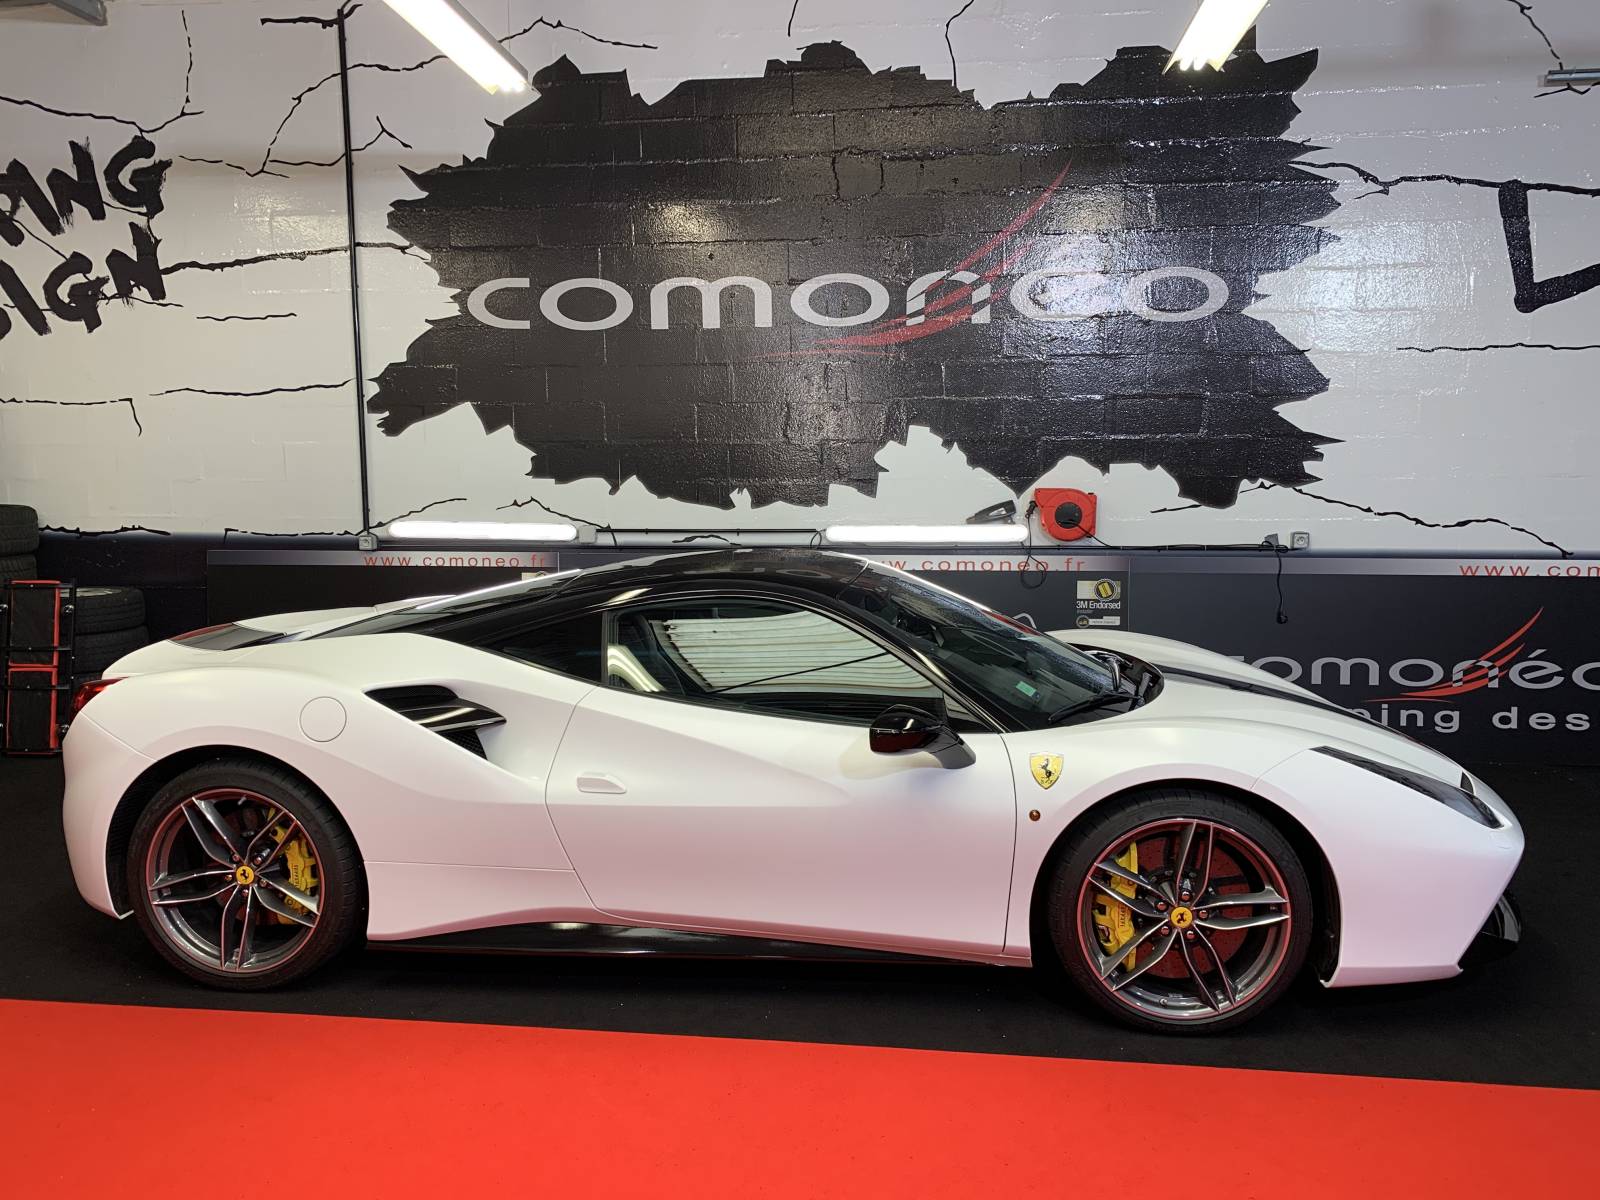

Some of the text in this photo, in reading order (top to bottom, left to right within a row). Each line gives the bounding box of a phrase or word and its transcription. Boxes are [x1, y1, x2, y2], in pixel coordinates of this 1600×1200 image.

[0, 221, 166, 341] IGN
[364, 554, 546, 567] www.comoneo.fr
[881, 557, 1086, 572] w.comoneo.fr
[1076, 600, 1121, 609] 3M Endorsed
[1226, 649, 1600, 691] omoné
[1492, 706, 1591, 731] des
